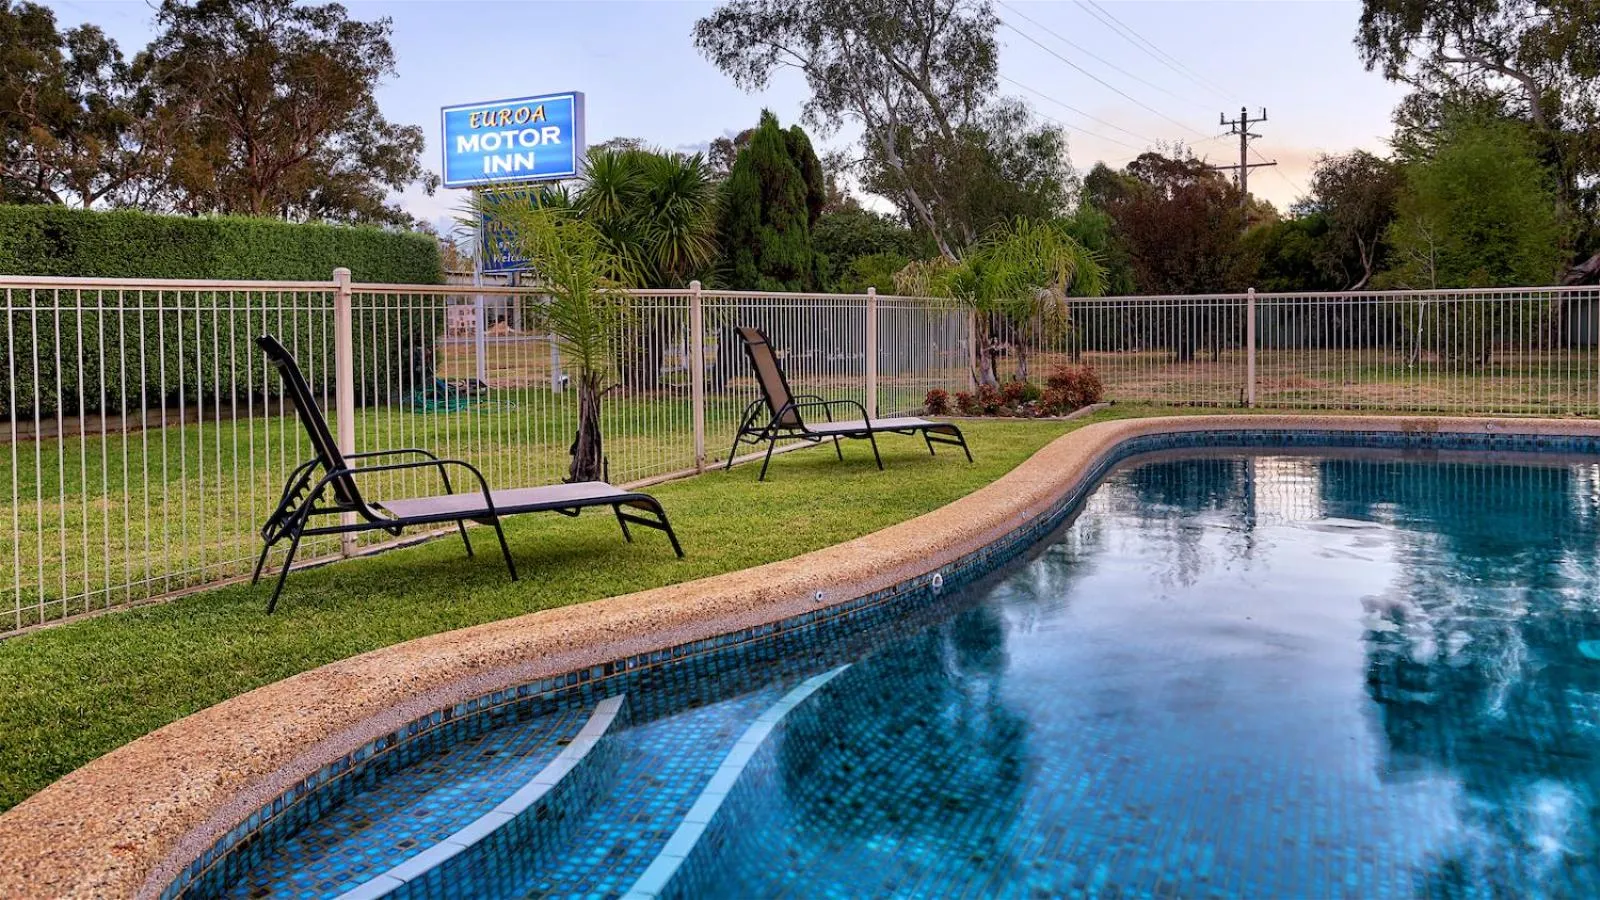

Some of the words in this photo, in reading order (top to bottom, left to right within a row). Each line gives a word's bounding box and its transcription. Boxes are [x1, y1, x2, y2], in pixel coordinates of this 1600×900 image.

[470, 104, 546, 128] EUROA
[456, 126, 562, 154] MOTOR
[484, 152, 534, 174] INN
